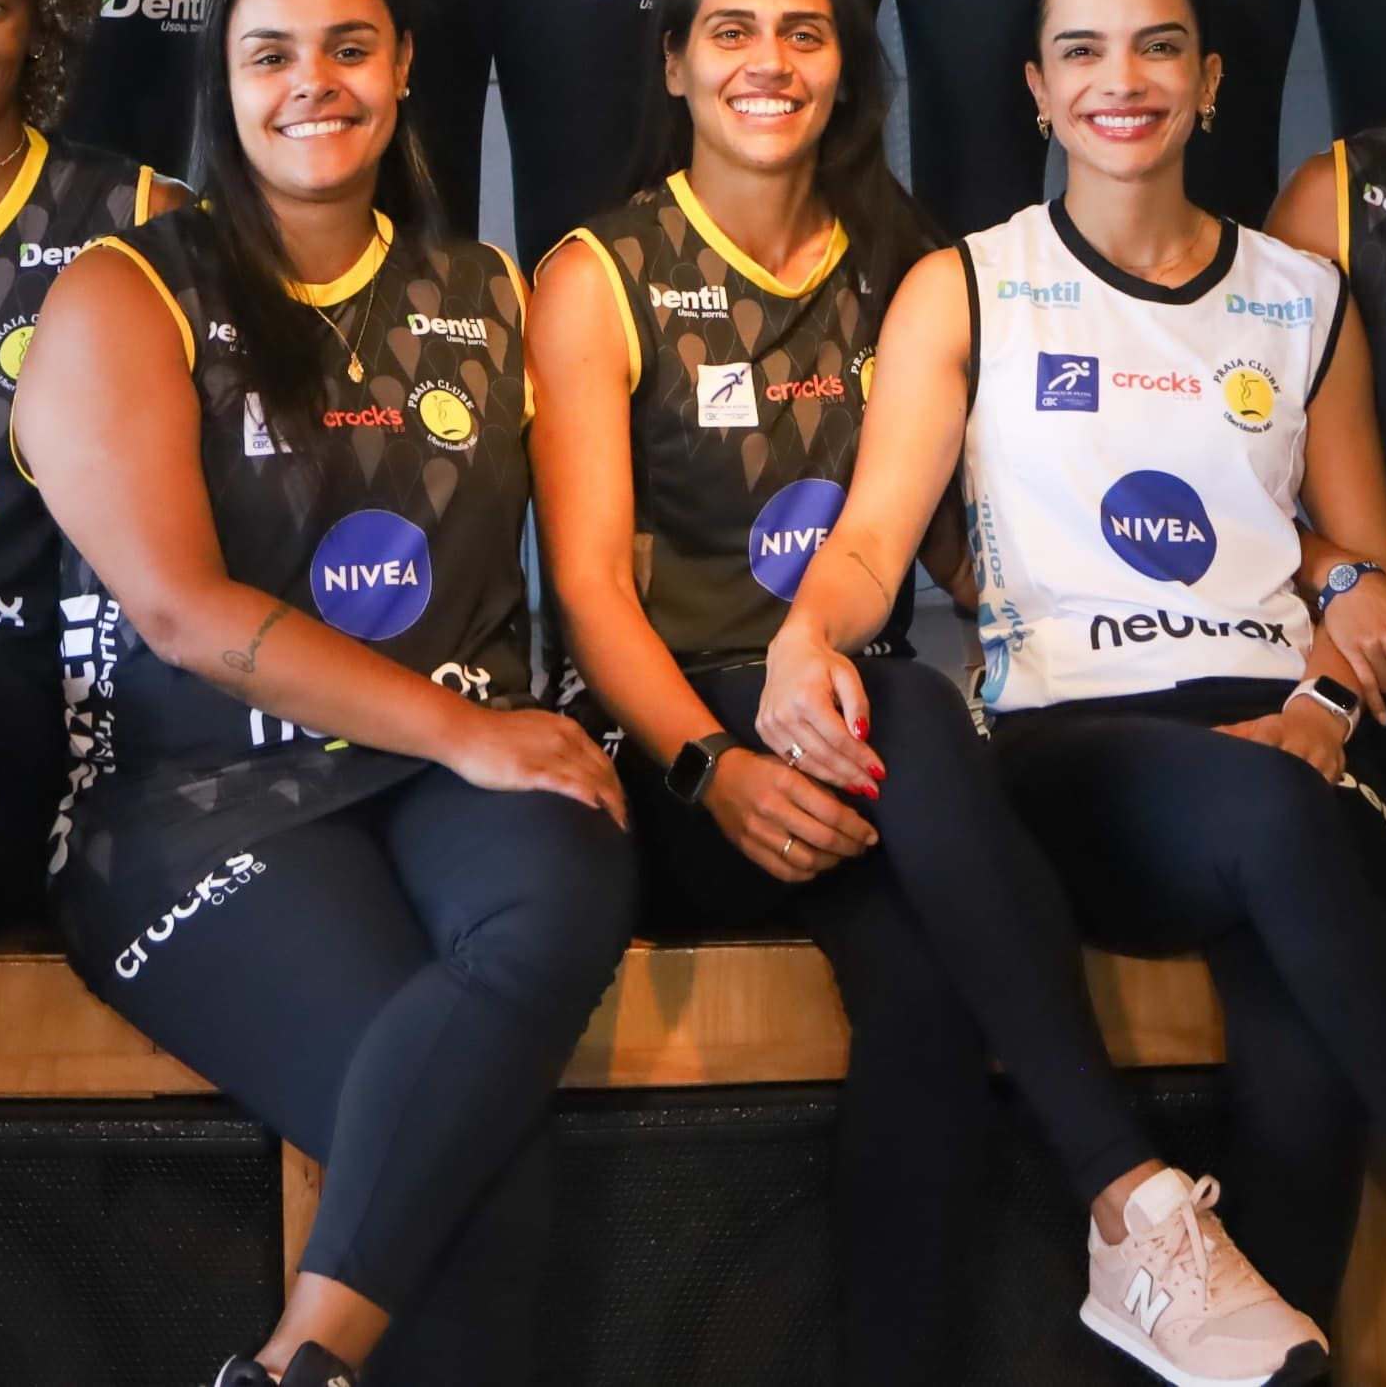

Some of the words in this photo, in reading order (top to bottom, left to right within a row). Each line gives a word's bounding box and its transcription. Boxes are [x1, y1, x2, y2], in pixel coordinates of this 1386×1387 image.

[998, 280, 1081, 303] Dentil
[1226, 293, 1313, 322] Dentil
[408, 313, 487, 341] Dentil
[1213, 358, 1245, 384] PRAIA
[1248, 359, 1282, 396] CLUBE
[407, 379, 435, 409] PRAIA
[437, 379, 476, 414] CLUBE
[760, 527, 830, 556] NIVE
[1110, 516, 1206, 543] NIVEA
[324, 559, 419, 591] NIVEA
[211, 860, 268, 905] CLUB
[1123, 1266, 1174, 1340] N
